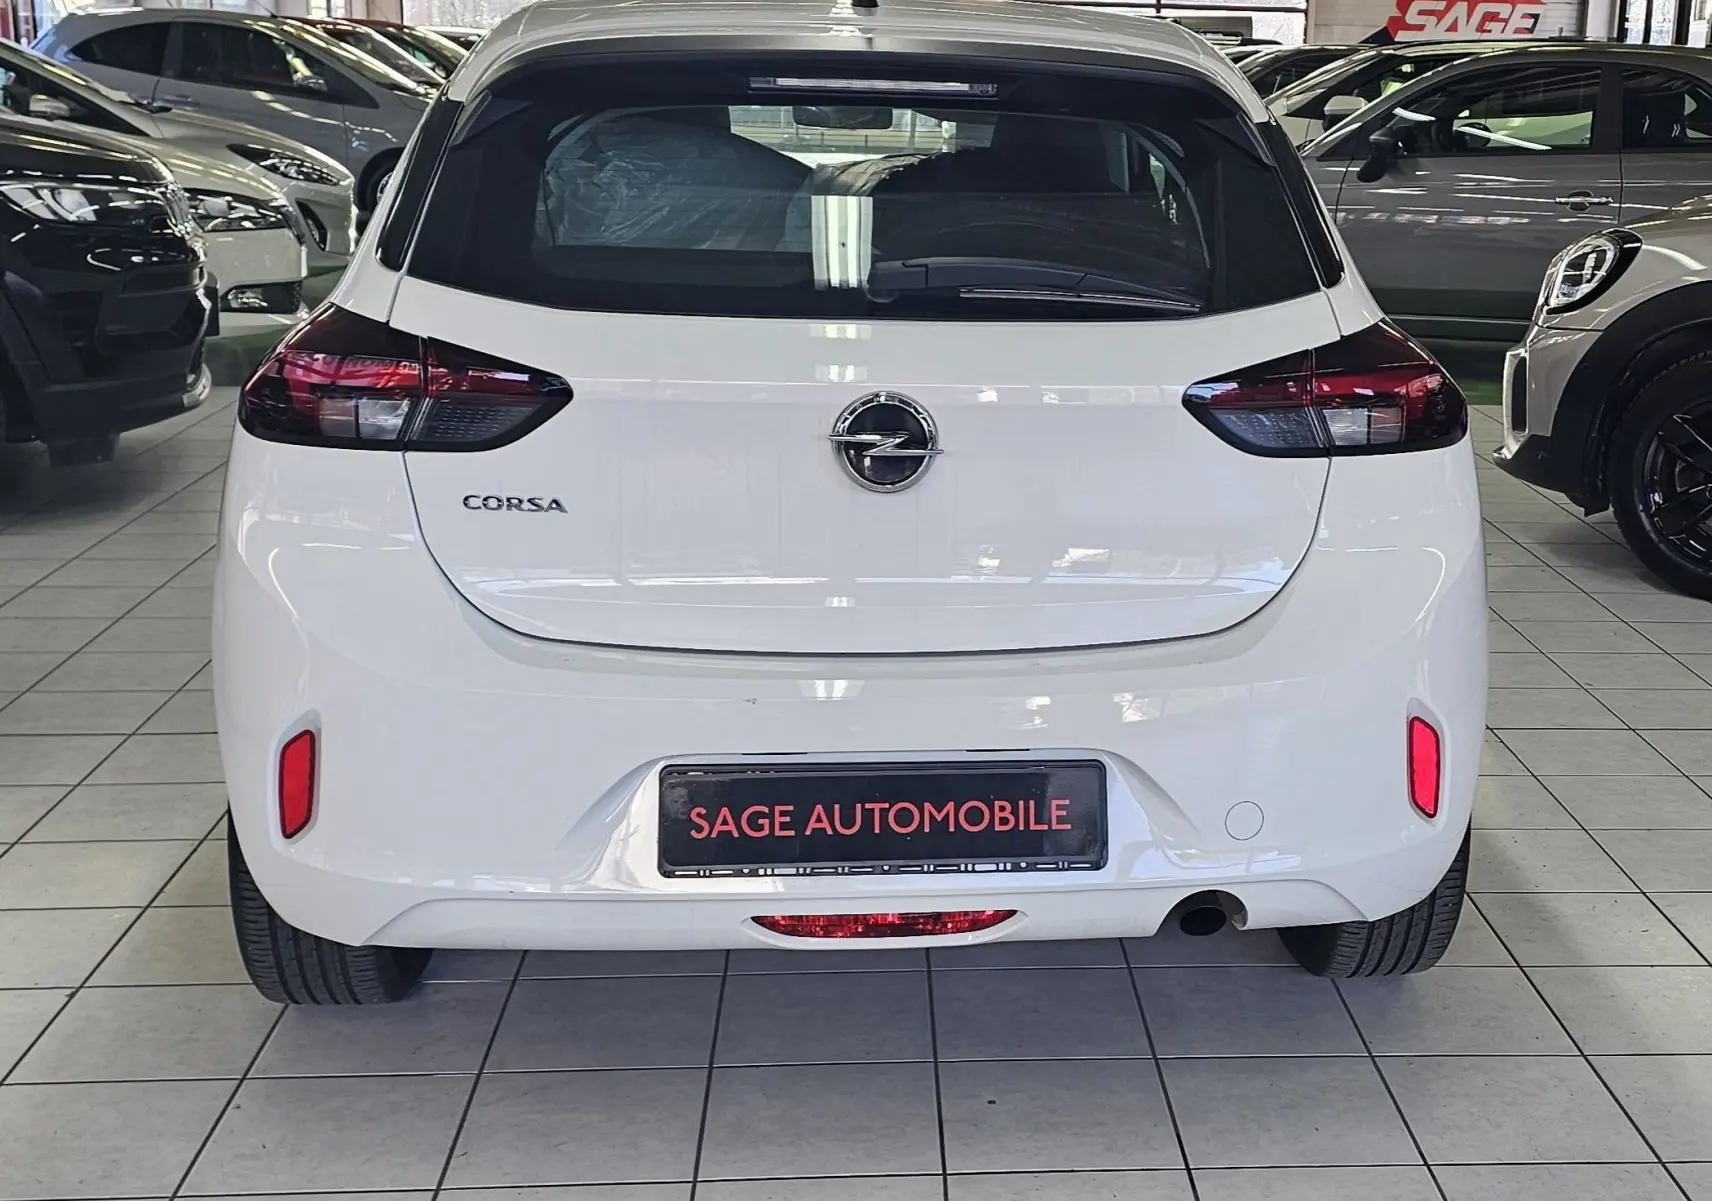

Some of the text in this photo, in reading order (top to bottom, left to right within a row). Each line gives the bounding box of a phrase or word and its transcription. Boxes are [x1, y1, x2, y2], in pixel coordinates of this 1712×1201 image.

[1394, 1, 1545, 41] SAGE
[462, 494, 568, 514] CORSA
[689, 799, 1073, 839] SAGE AUTOMOBILE
